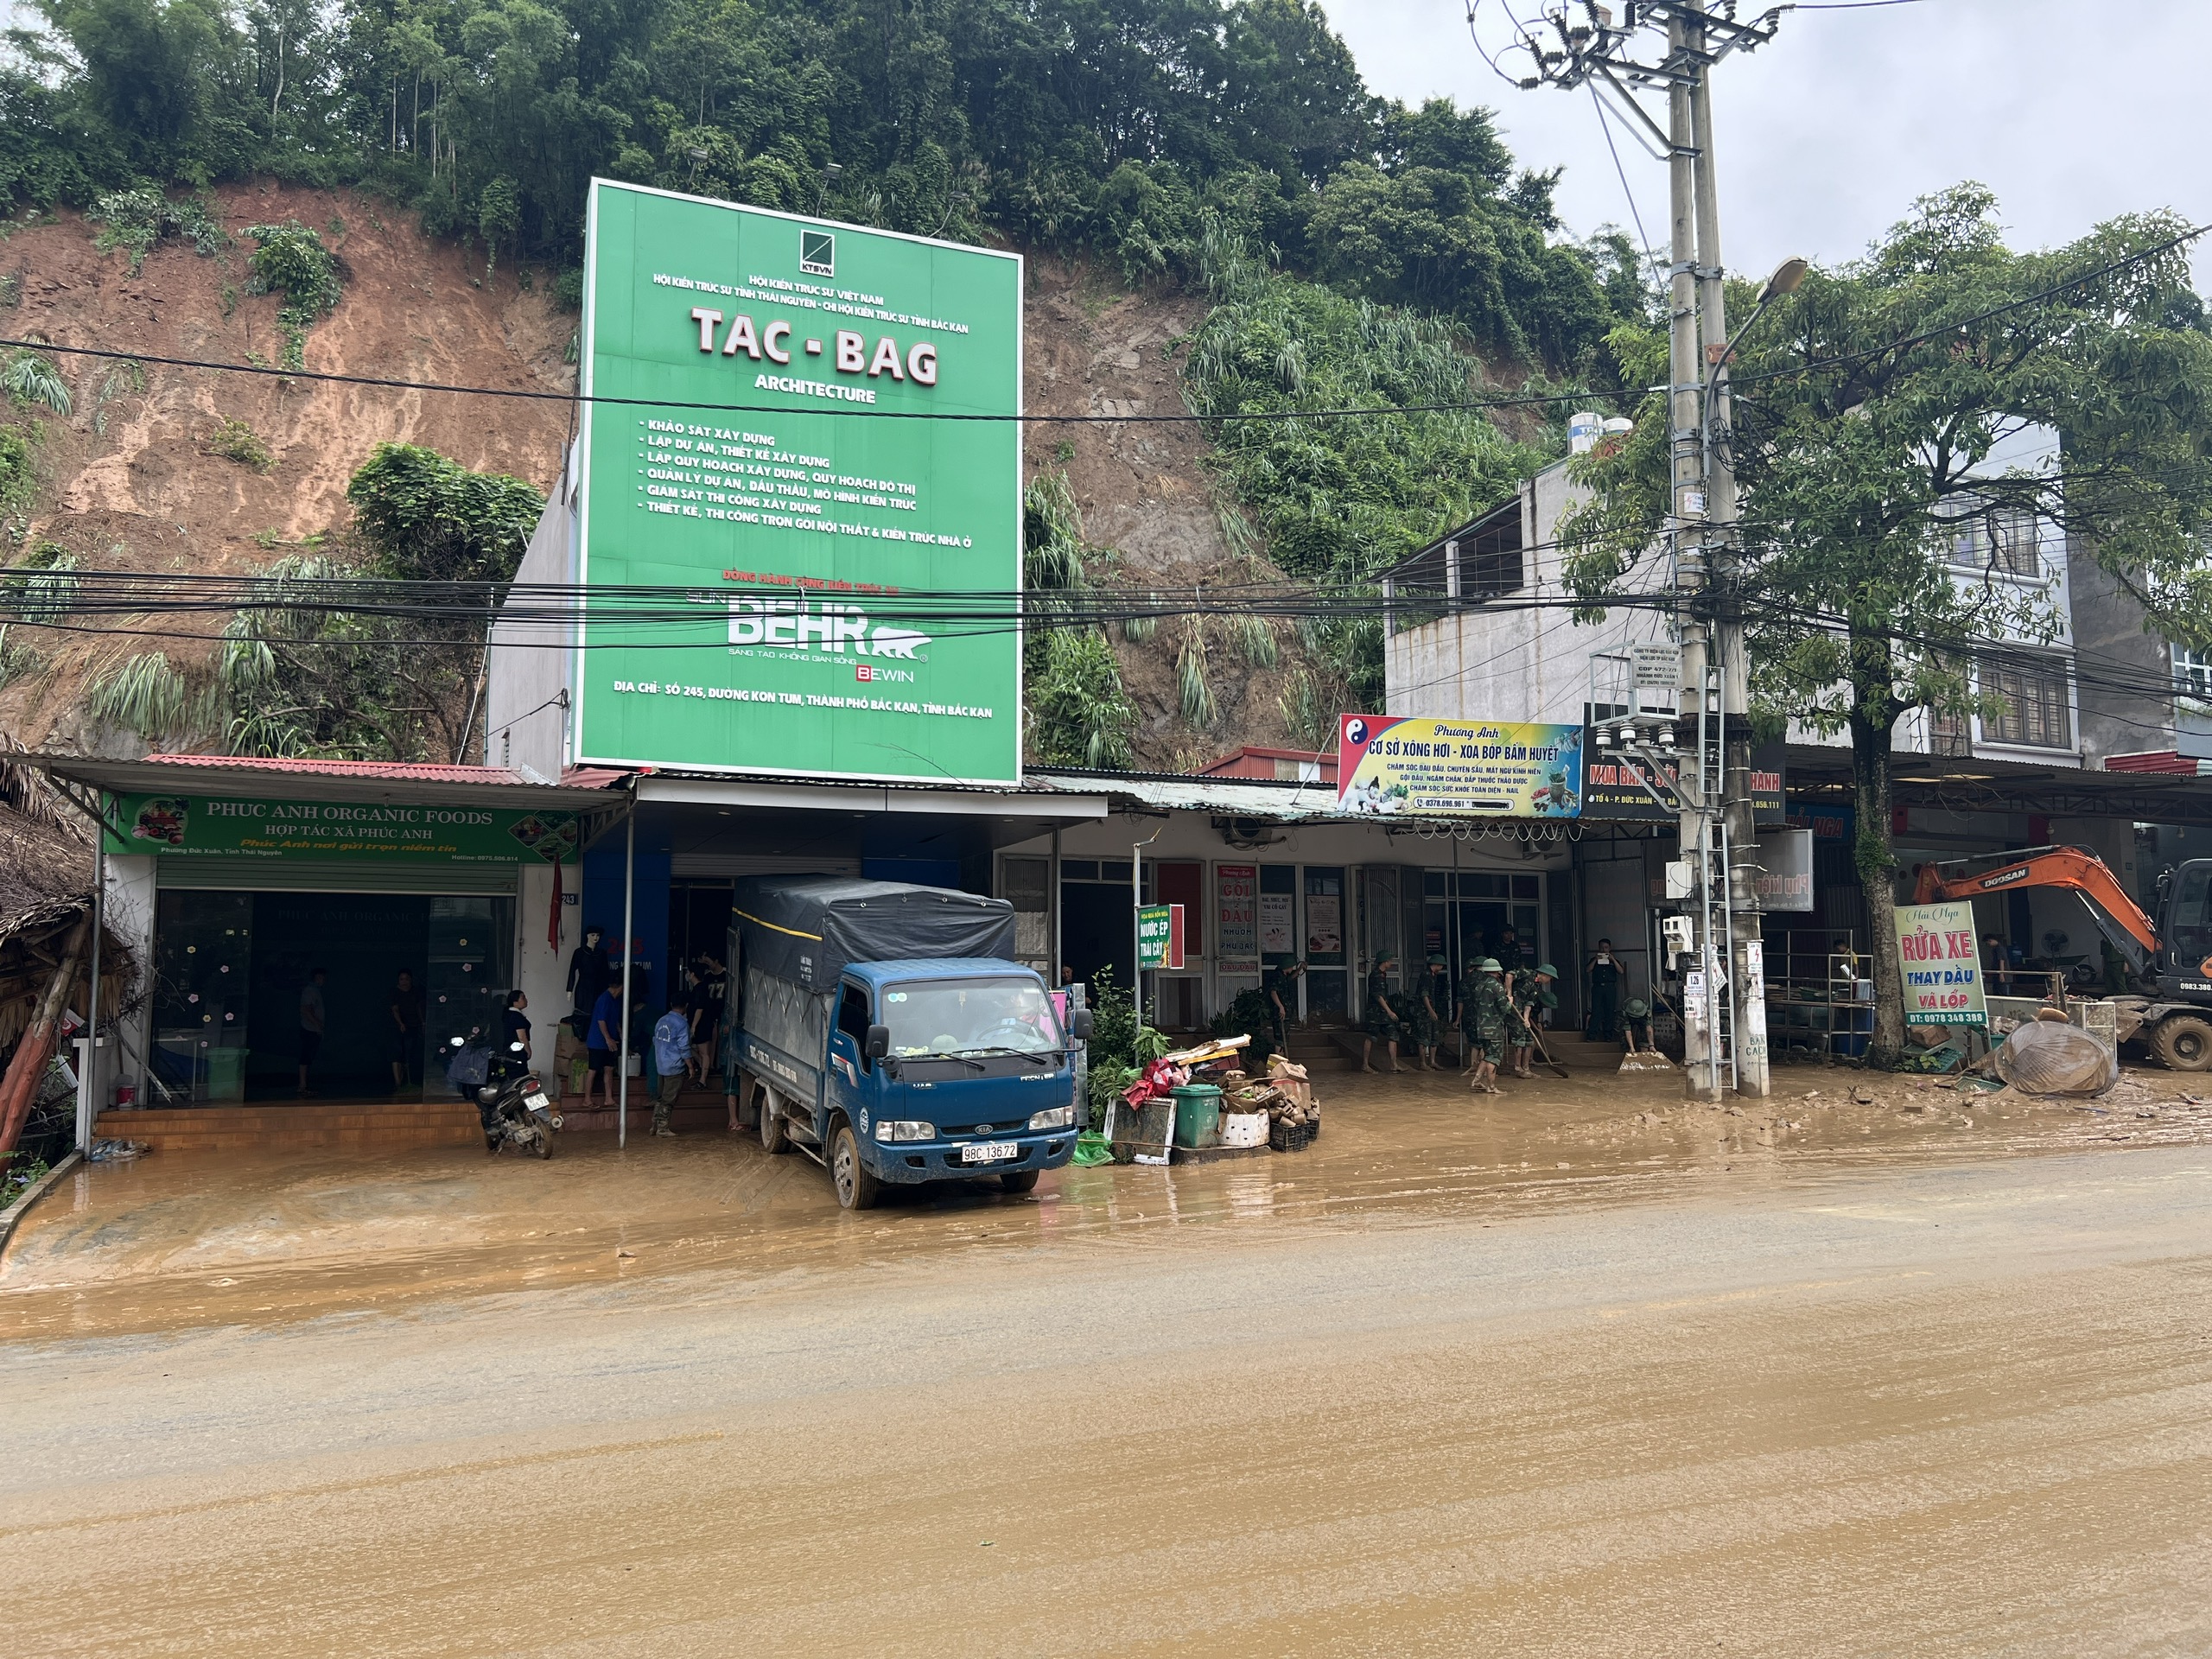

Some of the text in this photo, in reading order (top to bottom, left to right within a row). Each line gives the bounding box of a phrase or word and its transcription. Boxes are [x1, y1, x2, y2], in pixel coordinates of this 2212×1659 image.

[802, 263, 832, 275] KTSVN
[749, 275, 884, 306] HỘI KIẾN TRÚC SƯ VIỆT NAM
[691, 307, 791, 363] TAC
[836, 329, 937, 385] BAG
[754, 373, 875, 404] ARCHITECTURE
[648, 419, 775, 447] KHẢO SÁT XÂY DỰNG
[648, 435, 830, 468] LẬP DỰ ÁN, THIẾT KẾ XÂY DỰNG
[728, 594, 870, 656] BEHR
[728, 648, 753, 657] SÁNG
[779, 652, 810, 661] KHÔNG
[833, 656, 858, 666] SỐNG
[857, 666, 914, 683] BEWIN
[613, 680, 993, 719] ĐỊA CHỈ: SỐ 245, ĐƯỜNG KON TUM, THÀNH PHỐ BẮC KẠN, TỈNH BẮC KẠN
[1433, 724, 1499, 741] Phương Anh
[1369, 737, 1559, 765] CƠ SỞ XÔNG HƠI XOA BÓP BẤM HUYỆT
[1589, 763, 1645, 786] MUA BÁN
[1595, 793, 1604, 803] TỔ
[1621, 794, 1634, 804] ĐỨC
[1635, 796, 1652, 804] XUÂN
[207, 802, 493, 825] PHUC ANH ORGANIC FOODS
[264, 823, 433, 839] HỢP TÁC XÃ PHÚC ANH
[240, 838, 276, 848] Phúc
[280, 839, 310, 849] Anh
[1984, 868, 2026, 887] DOOSAN
[562, 895, 575, 905] 243
[1223, 881, 1250, 900] GỘI
[1221, 904, 1253, 923] ĐẦU
[1906, 906, 1959, 925] Hải Nga
[1141, 918, 1168, 938] NƯỚC ÉP
[1141, 938, 1163, 957] TRÁI CÂY
[1901, 925, 1974, 962] RỬA XE
[1907, 964, 1974, 985] THAY DẦU
[708, 983, 725, 999] 77
[1940, 988, 1969, 1008] LỐP
[1910, 1013, 1982, 1023] ĐT: 0978 348 388
